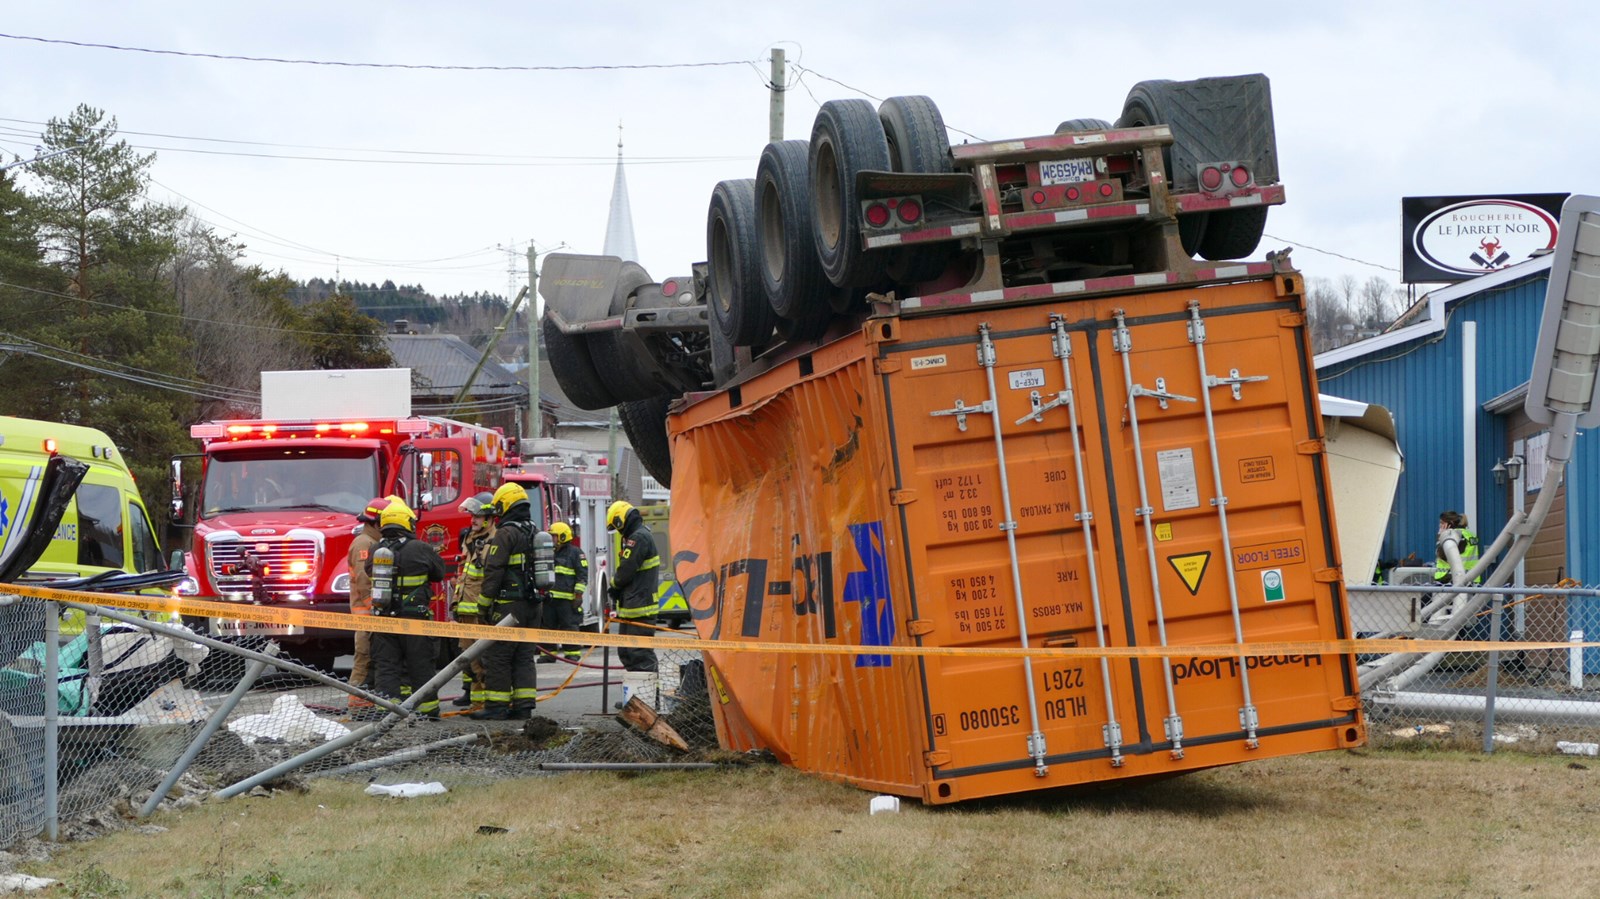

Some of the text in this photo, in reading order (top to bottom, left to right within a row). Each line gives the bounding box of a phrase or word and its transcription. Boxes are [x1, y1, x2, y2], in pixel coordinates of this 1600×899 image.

[1042, 161, 1092, 179] RM4593M
[1452, 214, 1522, 222] BOUCHERIE
[1439, 224, 1540, 236] LE JARRET NOIR
[958, 476, 973, 486] 172
[1044, 470, 1067, 483] CUBE
[935, 478, 952, 489] cuft
[960, 488, 978, 500] 33.2
[942, 506, 992, 519] 66 800 lbs
[1020, 504, 1051, 518] PAYLOAD
[948, 519, 993, 532] 30 300 kg
[1238, 546, 1300, 564] STEEL FLOOR
[970, 576, 986, 587] 850
[1056, 570, 1079, 582] TARE
[951, 578, 965, 588] lbs
[956, 590, 967, 601] kg
[972, 589, 988, 600] 200
[955, 609, 969, 620] lbs
[1033, 604, 1061, 618] GROSS
[960, 619, 1006, 633] 32 500 kg
[1043, 668, 1084, 692] 22G1
[935, 696, 1087, 735] HLBU 350080 6
